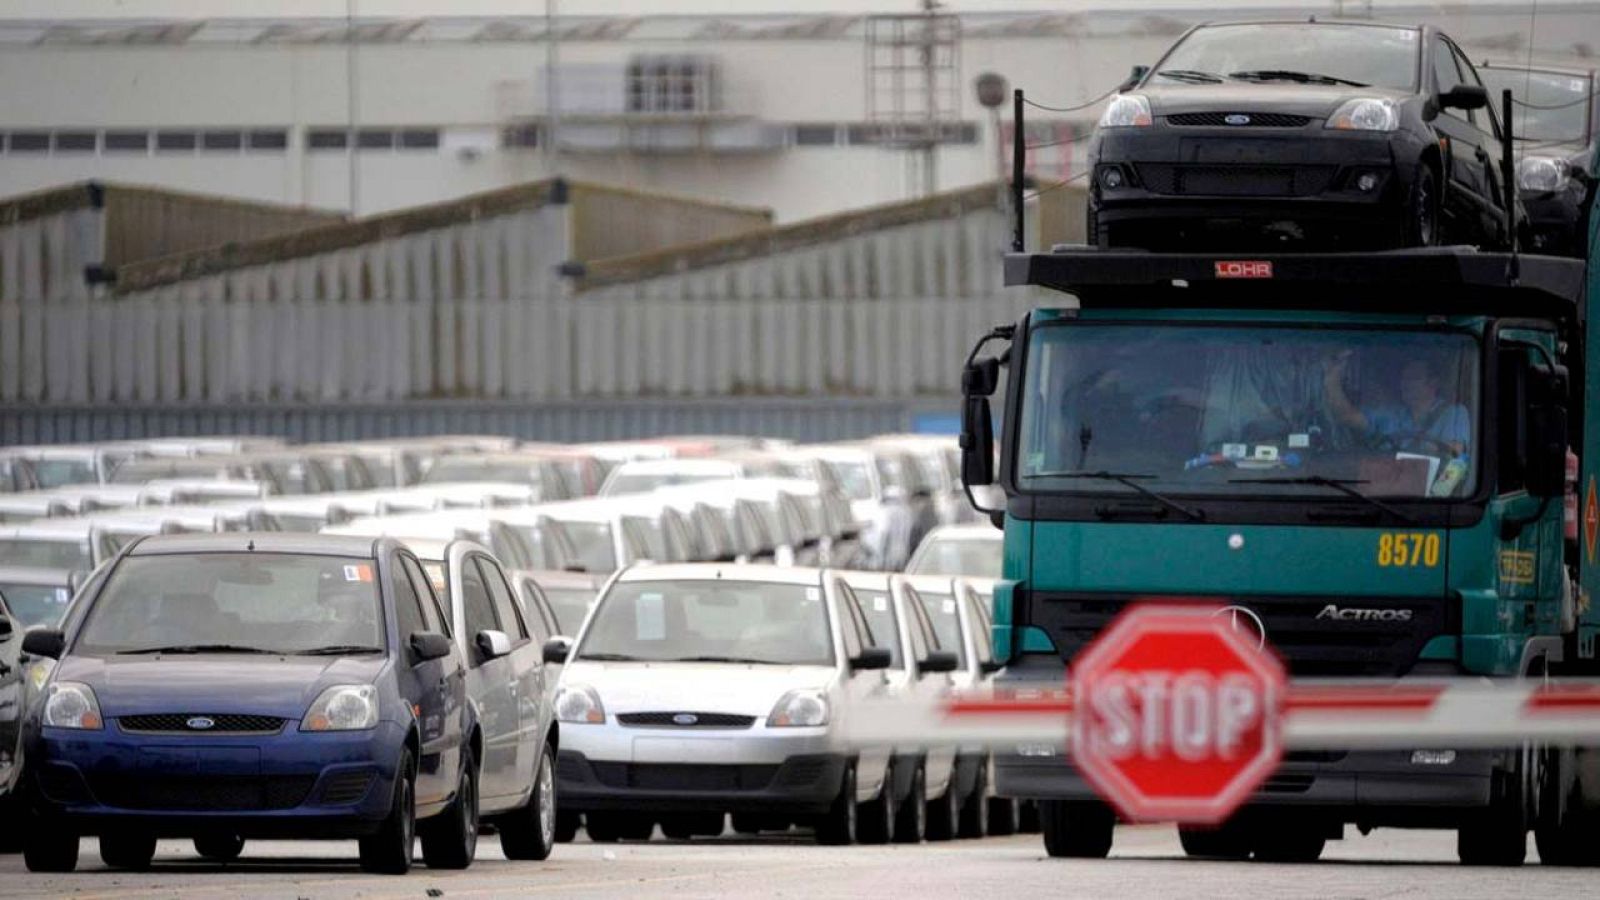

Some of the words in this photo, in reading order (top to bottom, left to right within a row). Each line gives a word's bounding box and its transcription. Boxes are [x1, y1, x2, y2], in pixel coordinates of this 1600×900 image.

[1217, 263, 1271, 276] LOHR
[1378, 533, 1440, 567] 8570
[1096, 671, 1255, 760] STOP
